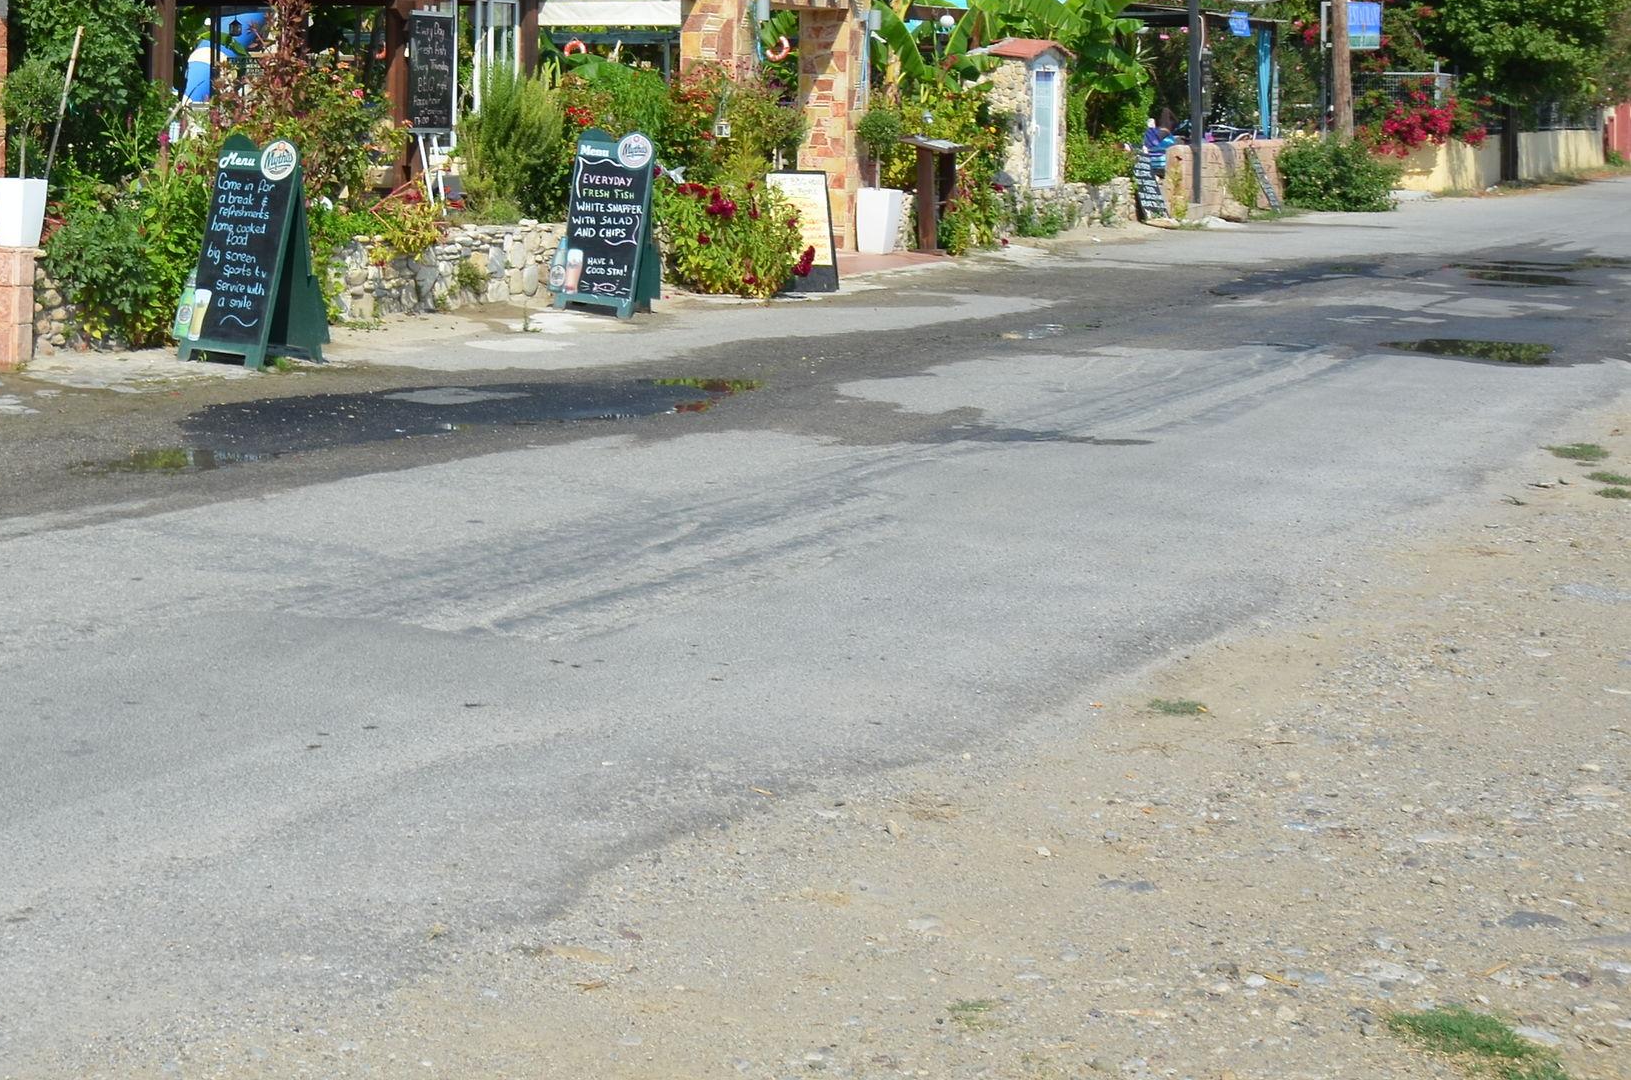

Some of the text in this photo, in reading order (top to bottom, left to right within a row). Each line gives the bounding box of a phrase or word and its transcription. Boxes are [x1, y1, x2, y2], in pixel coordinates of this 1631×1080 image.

[580, 144, 609, 157] Menu
[219, 151, 256, 169] Menu
[218, 171, 276, 194] Come in for
[583, 173, 633, 186] EVERYDAY
[218, 195, 226, 204] a
[228, 193, 254, 206] break
[582, 187, 635, 199] FRESH FISH
[219, 204, 270, 220] refreshments
[576, 201, 643, 214] WHITE SNAPPER
[211, 215, 266, 234] home cooked
[572, 216, 633, 225] WITH SALAD
[226, 231, 248, 246] food
[574, 227, 627, 238] AND CHIPS
[207, 242, 257, 265] big screen
[587, 257, 607, 266] HAVE
[585, 266, 606, 275] GOOD
[246, 281, 265, 296] with
[217, 294, 252, 309] a smile
